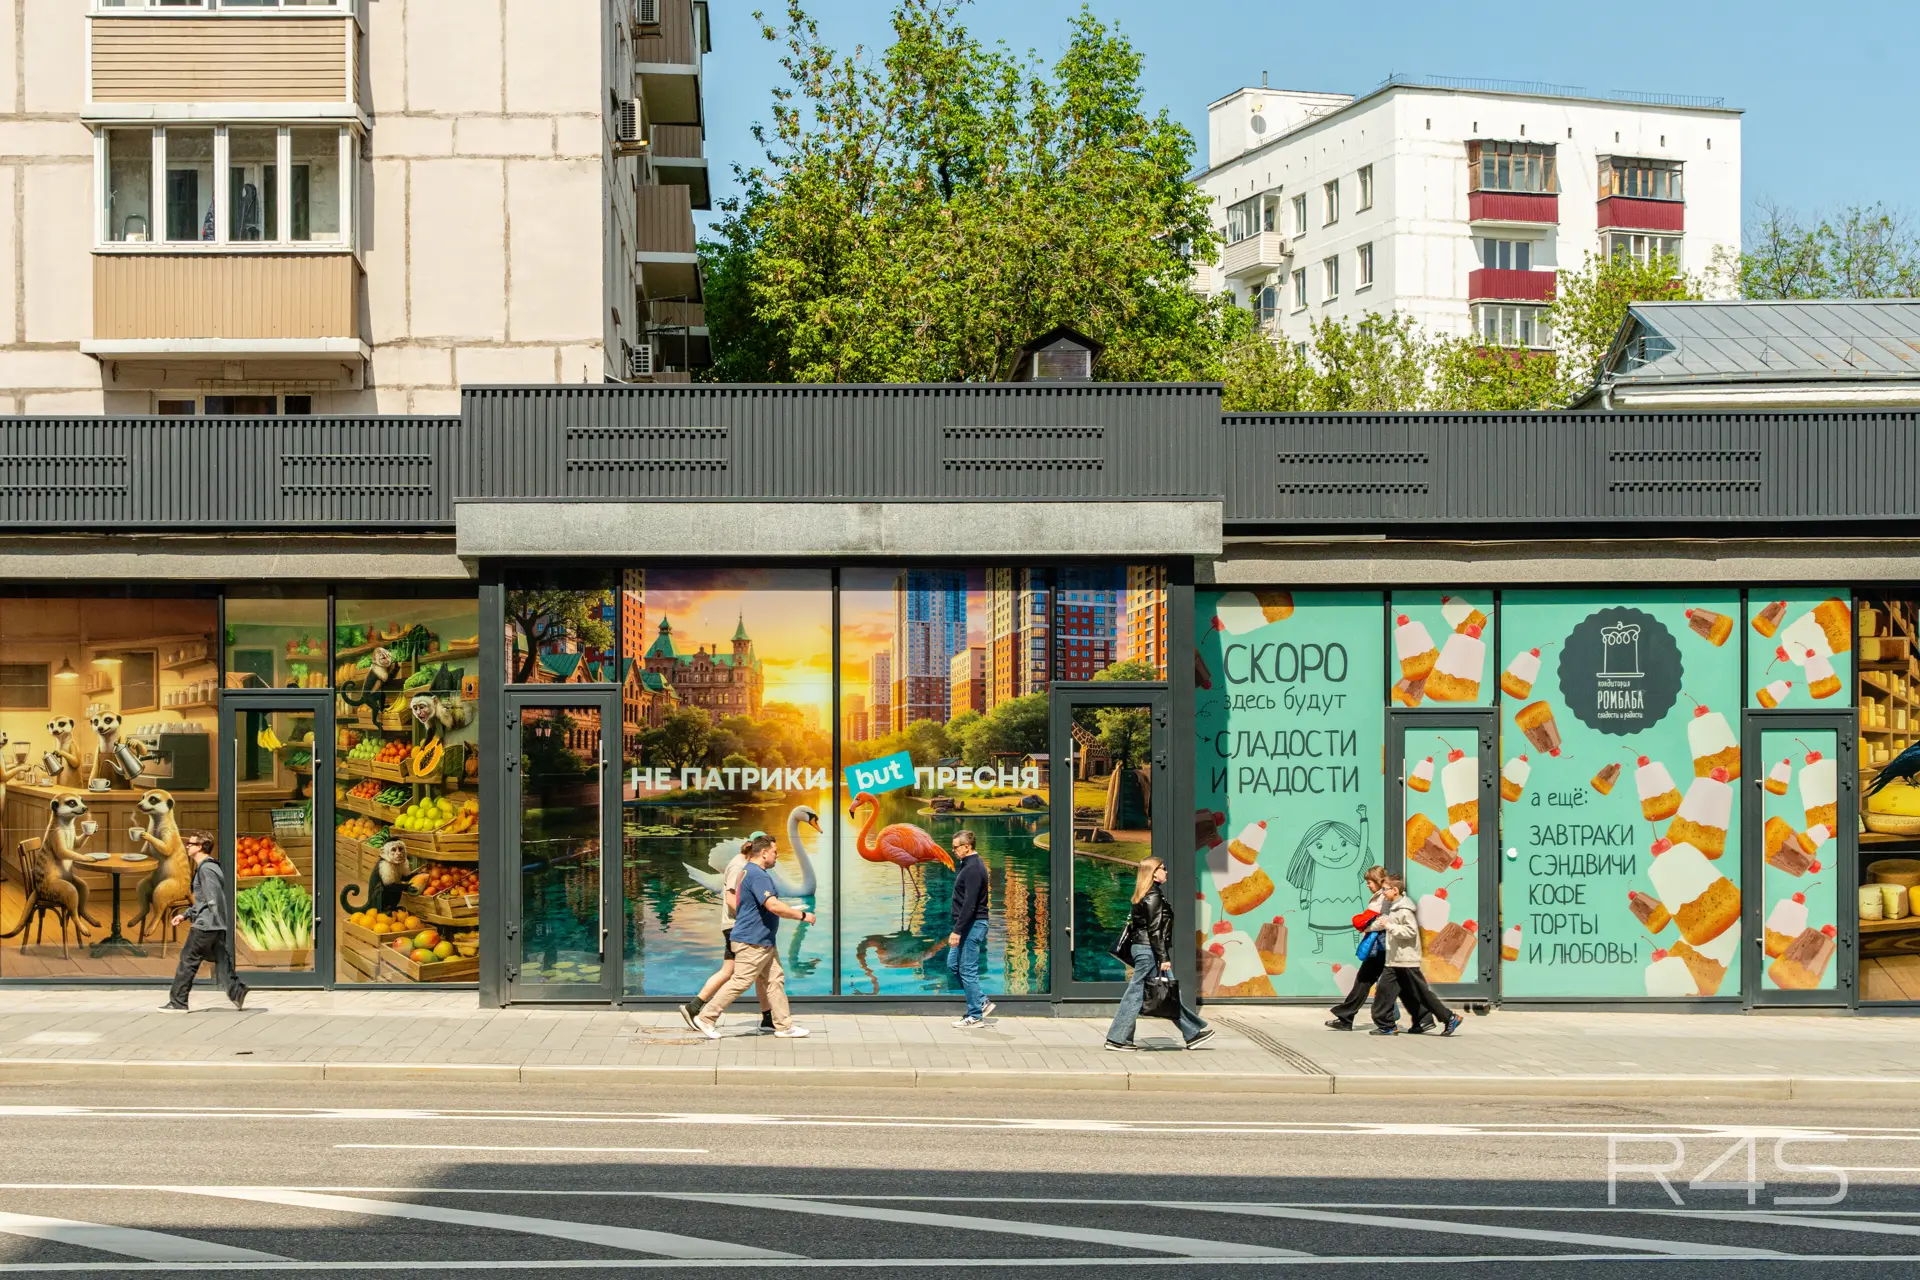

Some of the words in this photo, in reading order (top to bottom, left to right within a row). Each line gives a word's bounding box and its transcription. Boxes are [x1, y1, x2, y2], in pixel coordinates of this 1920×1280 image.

[1224, 642, 1348, 684] СКОРО
[1223, 693, 1276, 711] здесь
[1283, 686, 1347, 716] будут
[1597, 690, 1644, 709] РОМБАБА
[1215, 729, 1357, 759] СЛАДОСТИ
[631, 767, 672, 790] НЕ
[681, 767, 827, 790] ПАТРИКИ
[855, 760, 904, 790] but
[914, 766, 1039, 790] ПРЕСНЯ
[1211, 766, 1228, 793] И
[1239, 765, 1359, 796] РАДОСТИ
[1531, 792, 1541, 807] а
[1547, 788, 1588, 808] ещё:
[1529, 824, 1634, 846] ЗАВТРАКИ
[1529, 854, 1636, 878] СЭНДВИЧИ
[1529, 883, 1587, 905] КОФЕ
[1530, 913, 1598, 934] ТОРТЫ
[1529, 943, 1542, 964] И
[1548, 942, 1638, 966] ЛЮБОВЬ!
